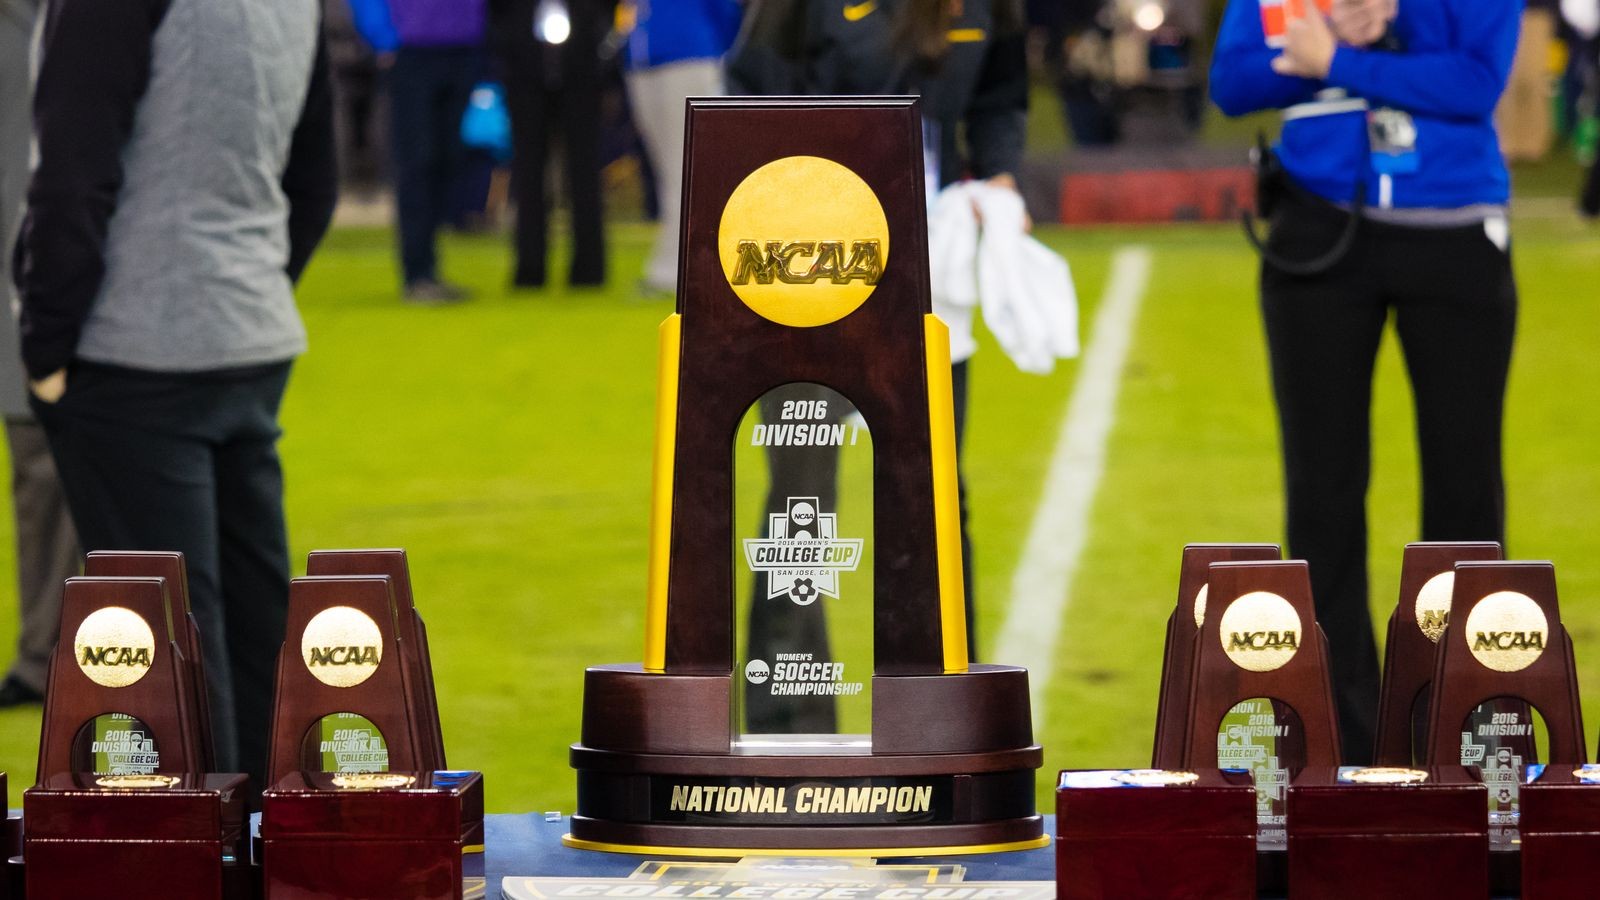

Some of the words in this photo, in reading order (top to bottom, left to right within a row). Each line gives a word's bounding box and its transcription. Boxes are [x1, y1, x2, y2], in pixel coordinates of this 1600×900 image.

[731, 239, 884, 286] NCAA
[781, 400, 828, 420] 2016
[751, 424, 846, 446] DIVISION
[850, 424, 859, 446] I
[755, 547, 821, 562] COLLEGE
[822, 547, 854, 562] CUP
[1227, 630, 1299, 652] NCAA
[1473, 631, 1544, 651] NCAA
[81, 646, 150, 667] NCAA
[309, 646, 379, 667] NCAA
[776, 653, 813, 661] WOMEN'S
[773, 662, 845, 681] SOCCER
[771, 682, 863, 695] CHAMPIONSHIP
[1249, 714, 1275, 725] 2016
[1491, 713, 1519, 724] 2016
[105, 730, 131, 741] 2016
[1478, 724, 1526, 736] DIVISION
[1527, 724, 1533, 736] I
[113, 755, 145, 763] COLLEGE
[341, 754, 374, 762] COLLEGE
[1464, 749, 1480, 757] CUP
[670, 785, 788, 813] NATIONAL
[795, 786, 932, 813] CHAMPION
[556, 884, 871, 898] COLLEGE
[875, 887, 1024, 900] CUP
